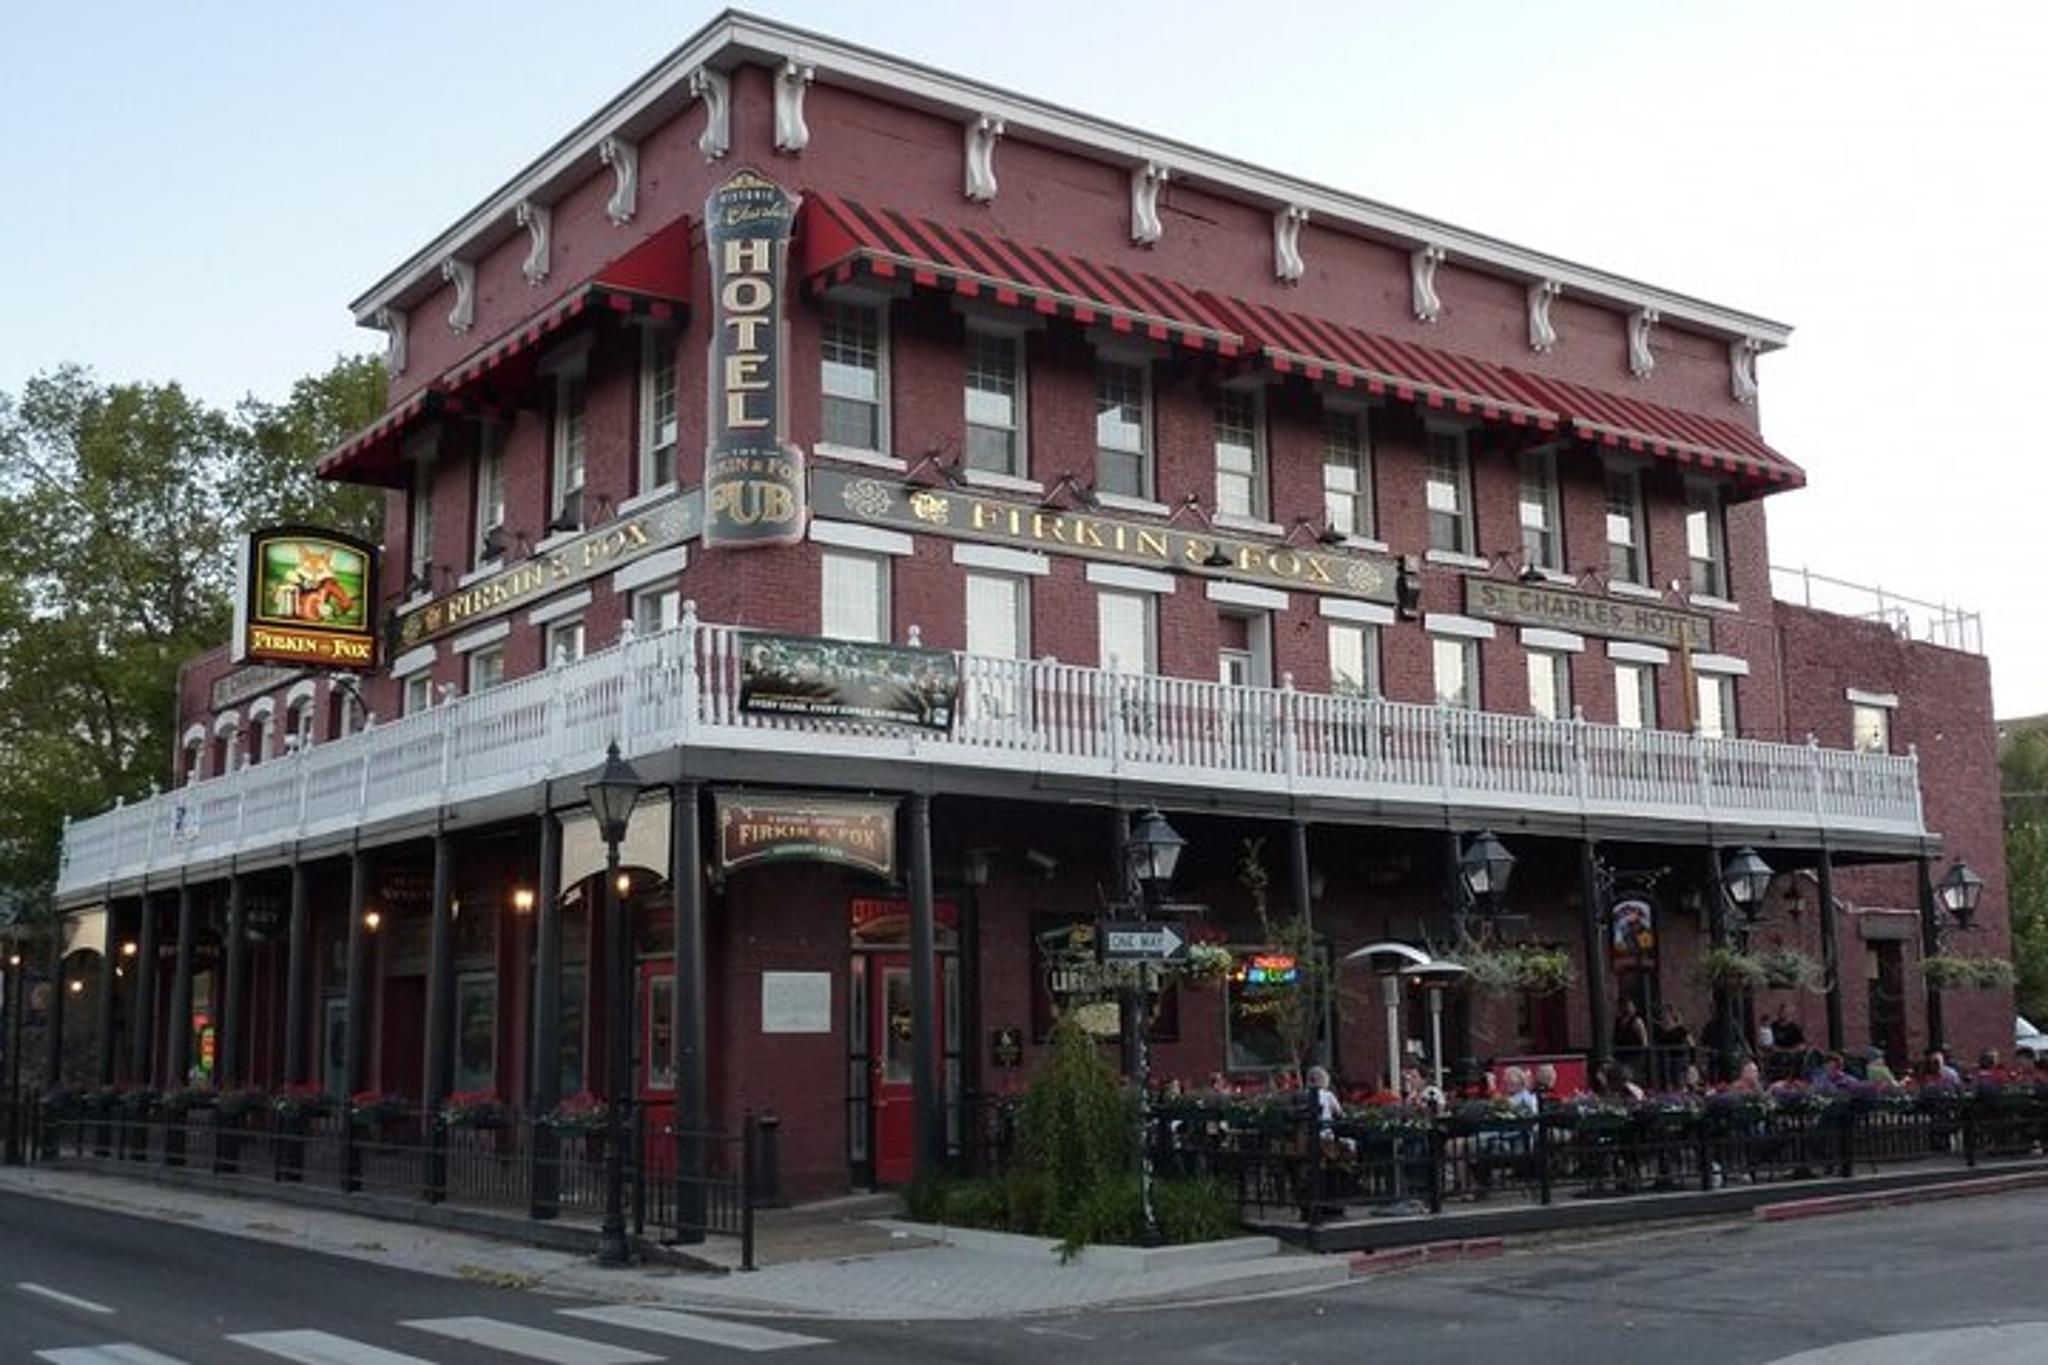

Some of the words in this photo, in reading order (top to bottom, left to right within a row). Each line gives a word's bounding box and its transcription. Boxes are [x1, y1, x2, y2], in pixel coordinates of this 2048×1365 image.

[721, 238, 774, 428] HOTEL
[710, 479, 795, 524] PUB
[972, 500, 1170, 560] FIRKIN
[1237, 546, 1336, 584] FOX
[448, 562, 544, 622] FIRKIN
[584, 521, 650, 567] FOX
[1517, 589, 1624, 627] CHARLES
[1634, 609, 1702, 640] HOTEL
[738, 823, 810, 846] FIRKIN
[837, 828, 876, 851] FOX
[1111, 934, 1136, 947] ONE
[1139, 934, 1164, 947] WAY
